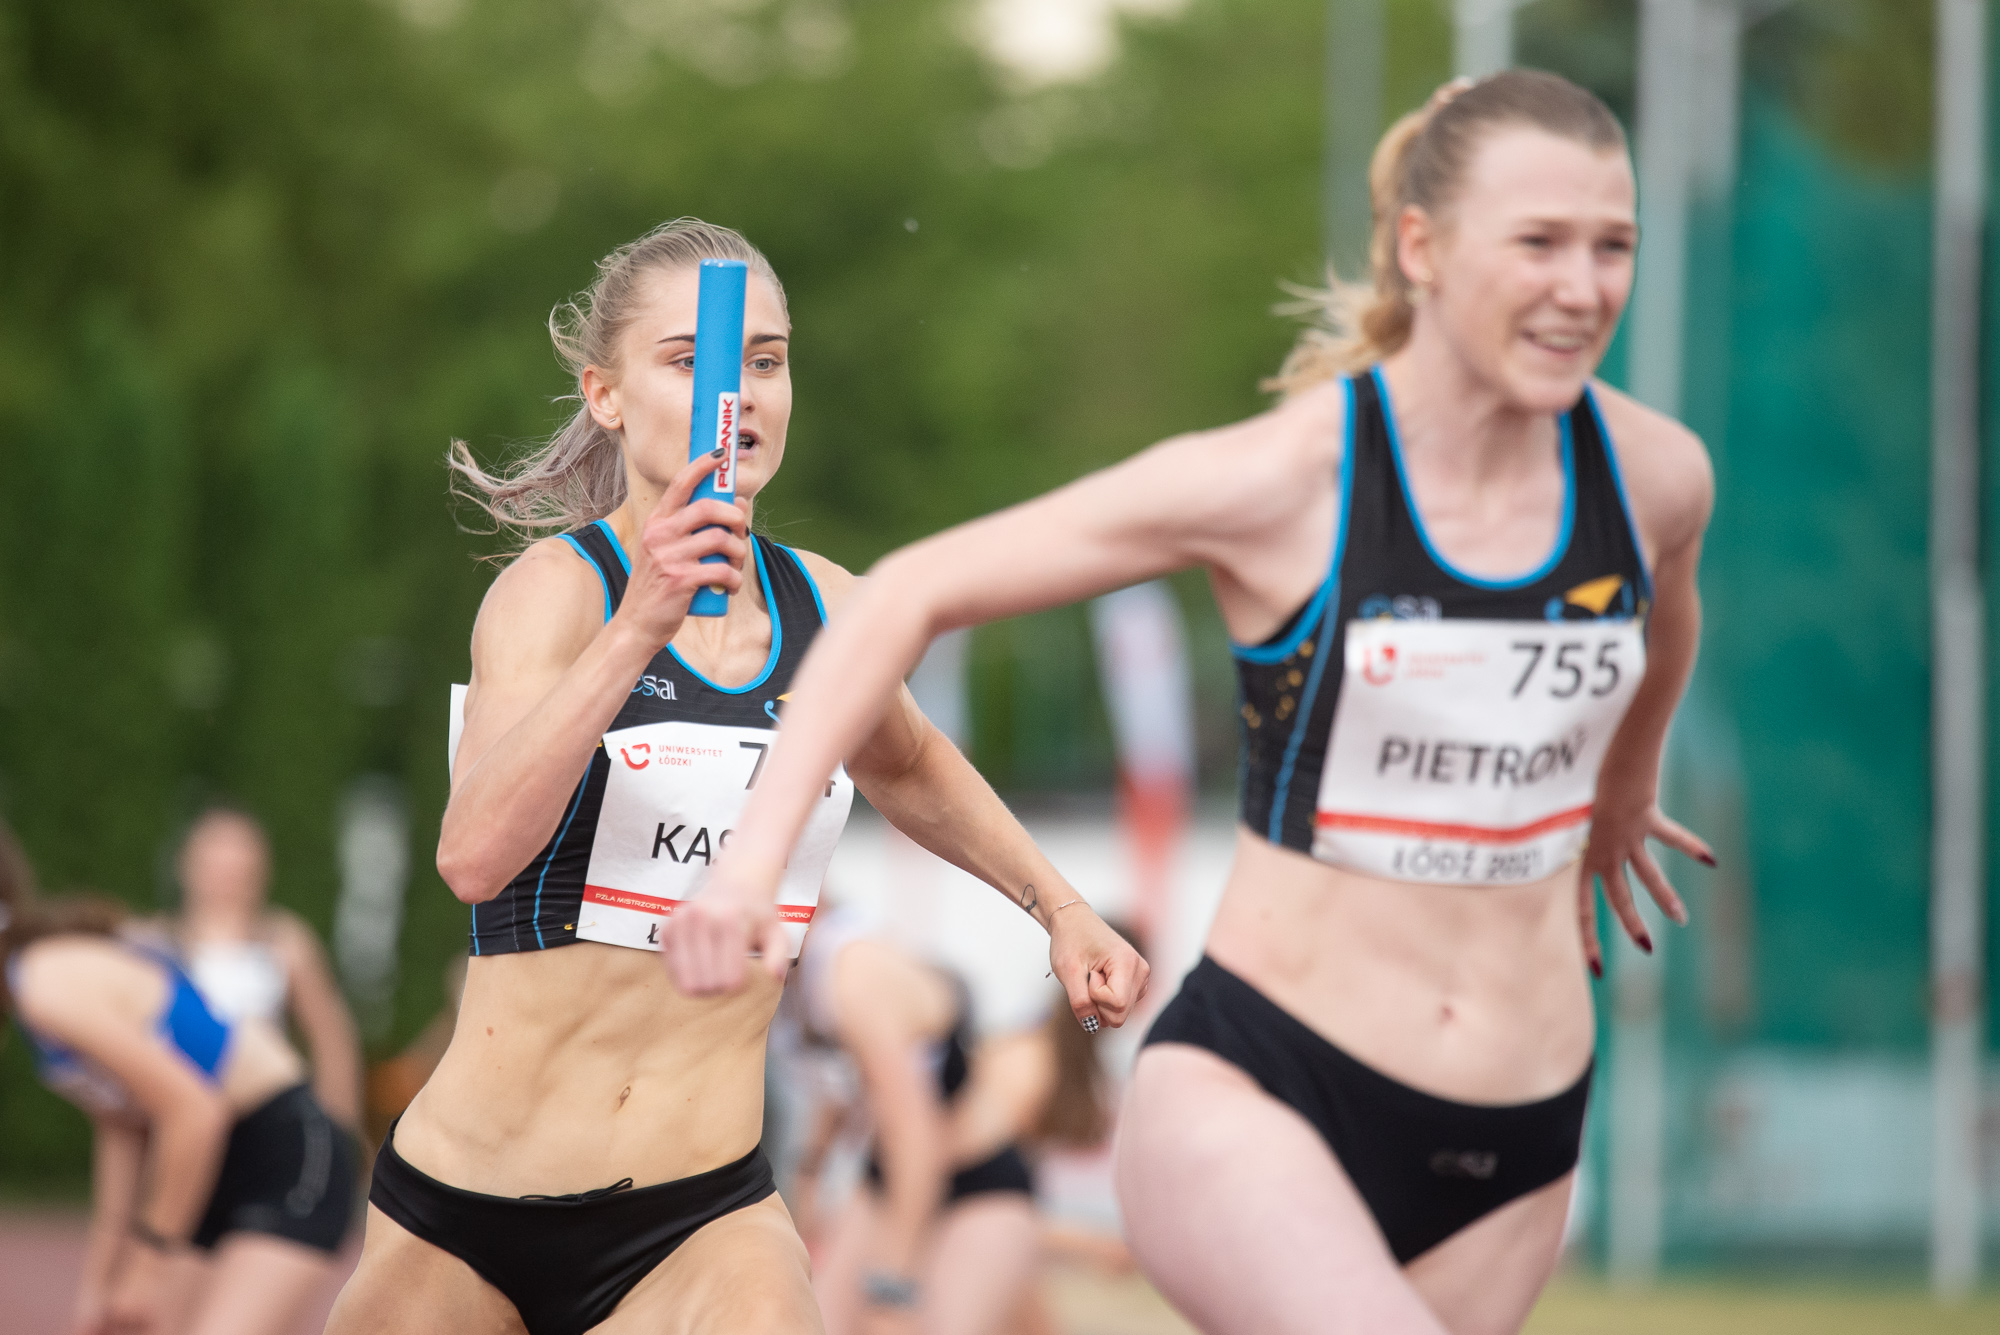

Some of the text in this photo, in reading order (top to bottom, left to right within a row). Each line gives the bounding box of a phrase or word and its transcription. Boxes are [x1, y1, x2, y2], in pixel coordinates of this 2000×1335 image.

[1509, 640, 1622, 700] 755
[658, 745, 723, 757] UNIWERSYTET
[658, 757, 692, 766] ŁÓDZKI
[595, 893, 616, 902] PZLA
[617, 897, 672, 912] MISTRZOSTWA
